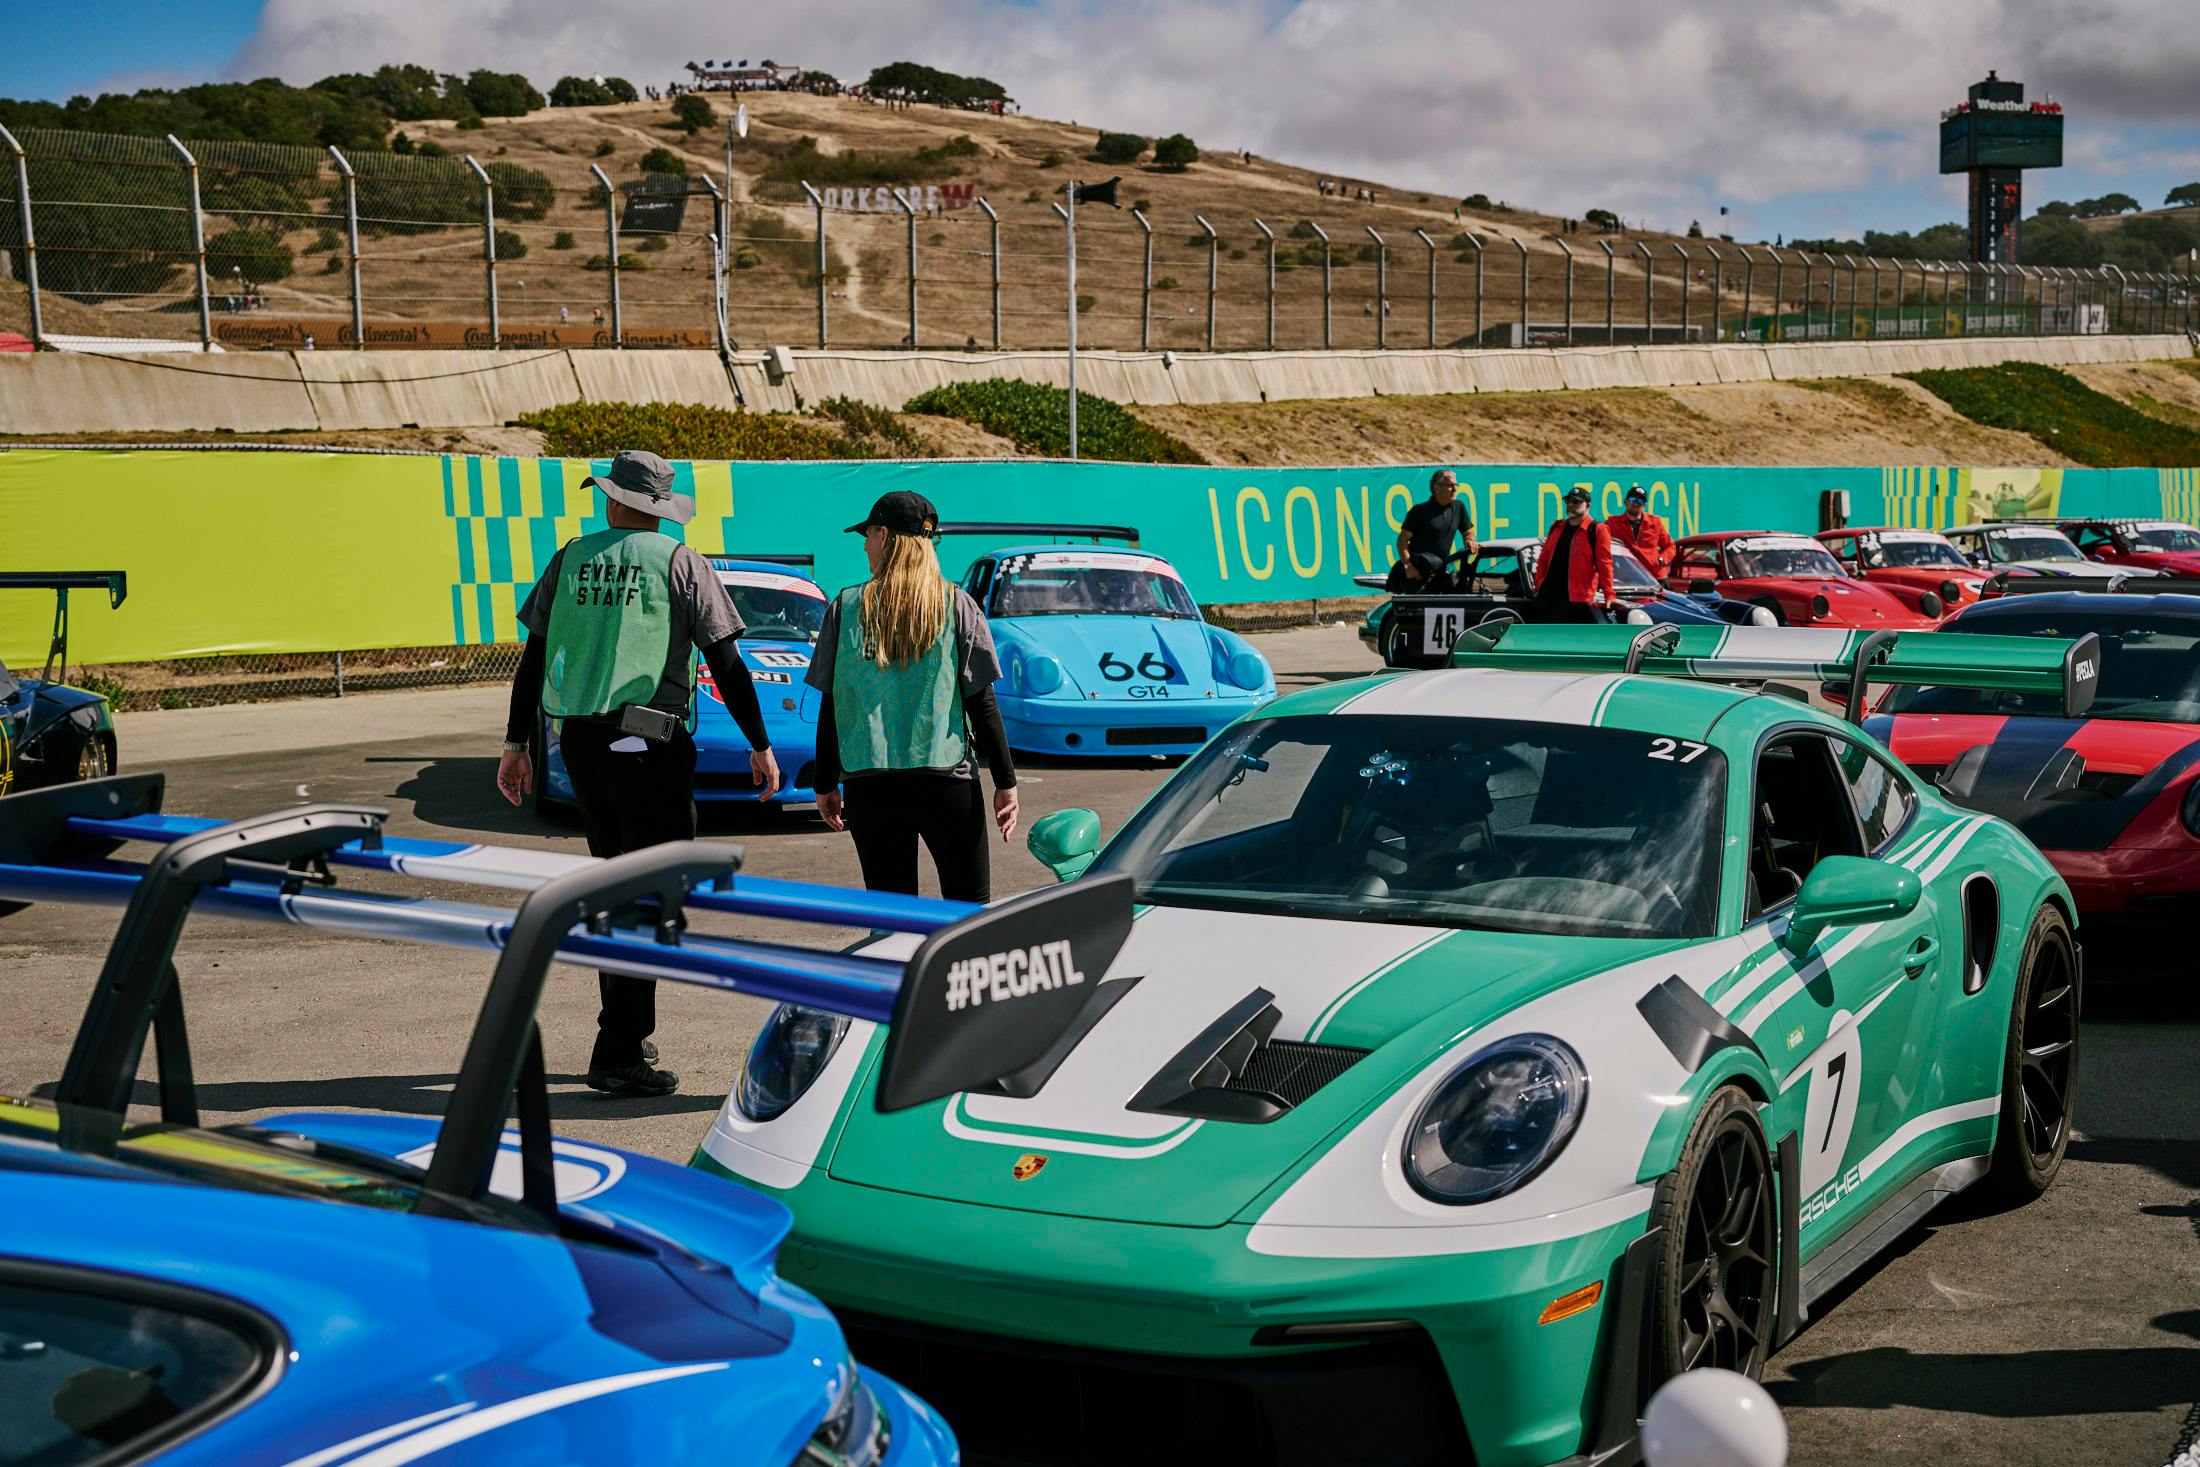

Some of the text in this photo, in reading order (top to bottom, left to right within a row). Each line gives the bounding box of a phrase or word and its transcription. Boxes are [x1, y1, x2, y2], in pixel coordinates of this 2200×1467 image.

[336, 325, 418, 343] Cotinental
[1208, 484, 1414, 580] ICONS
[1538, 480, 1700, 541] DSGN
[578, 563, 642, 583] EVENT
[577, 586, 640, 607] STAFF
[1431, 613, 1457, 649] 46
[1098, 652, 1176, 682] 66
[1128, 685, 1170, 699] GT4
[1647, 737, 1709, 764] 27
[945, 938, 1086, 1012] #PECATL
[1820, 1051, 1847, 1155] 7
[1799, 1163, 1862, 1231] RSCHE
